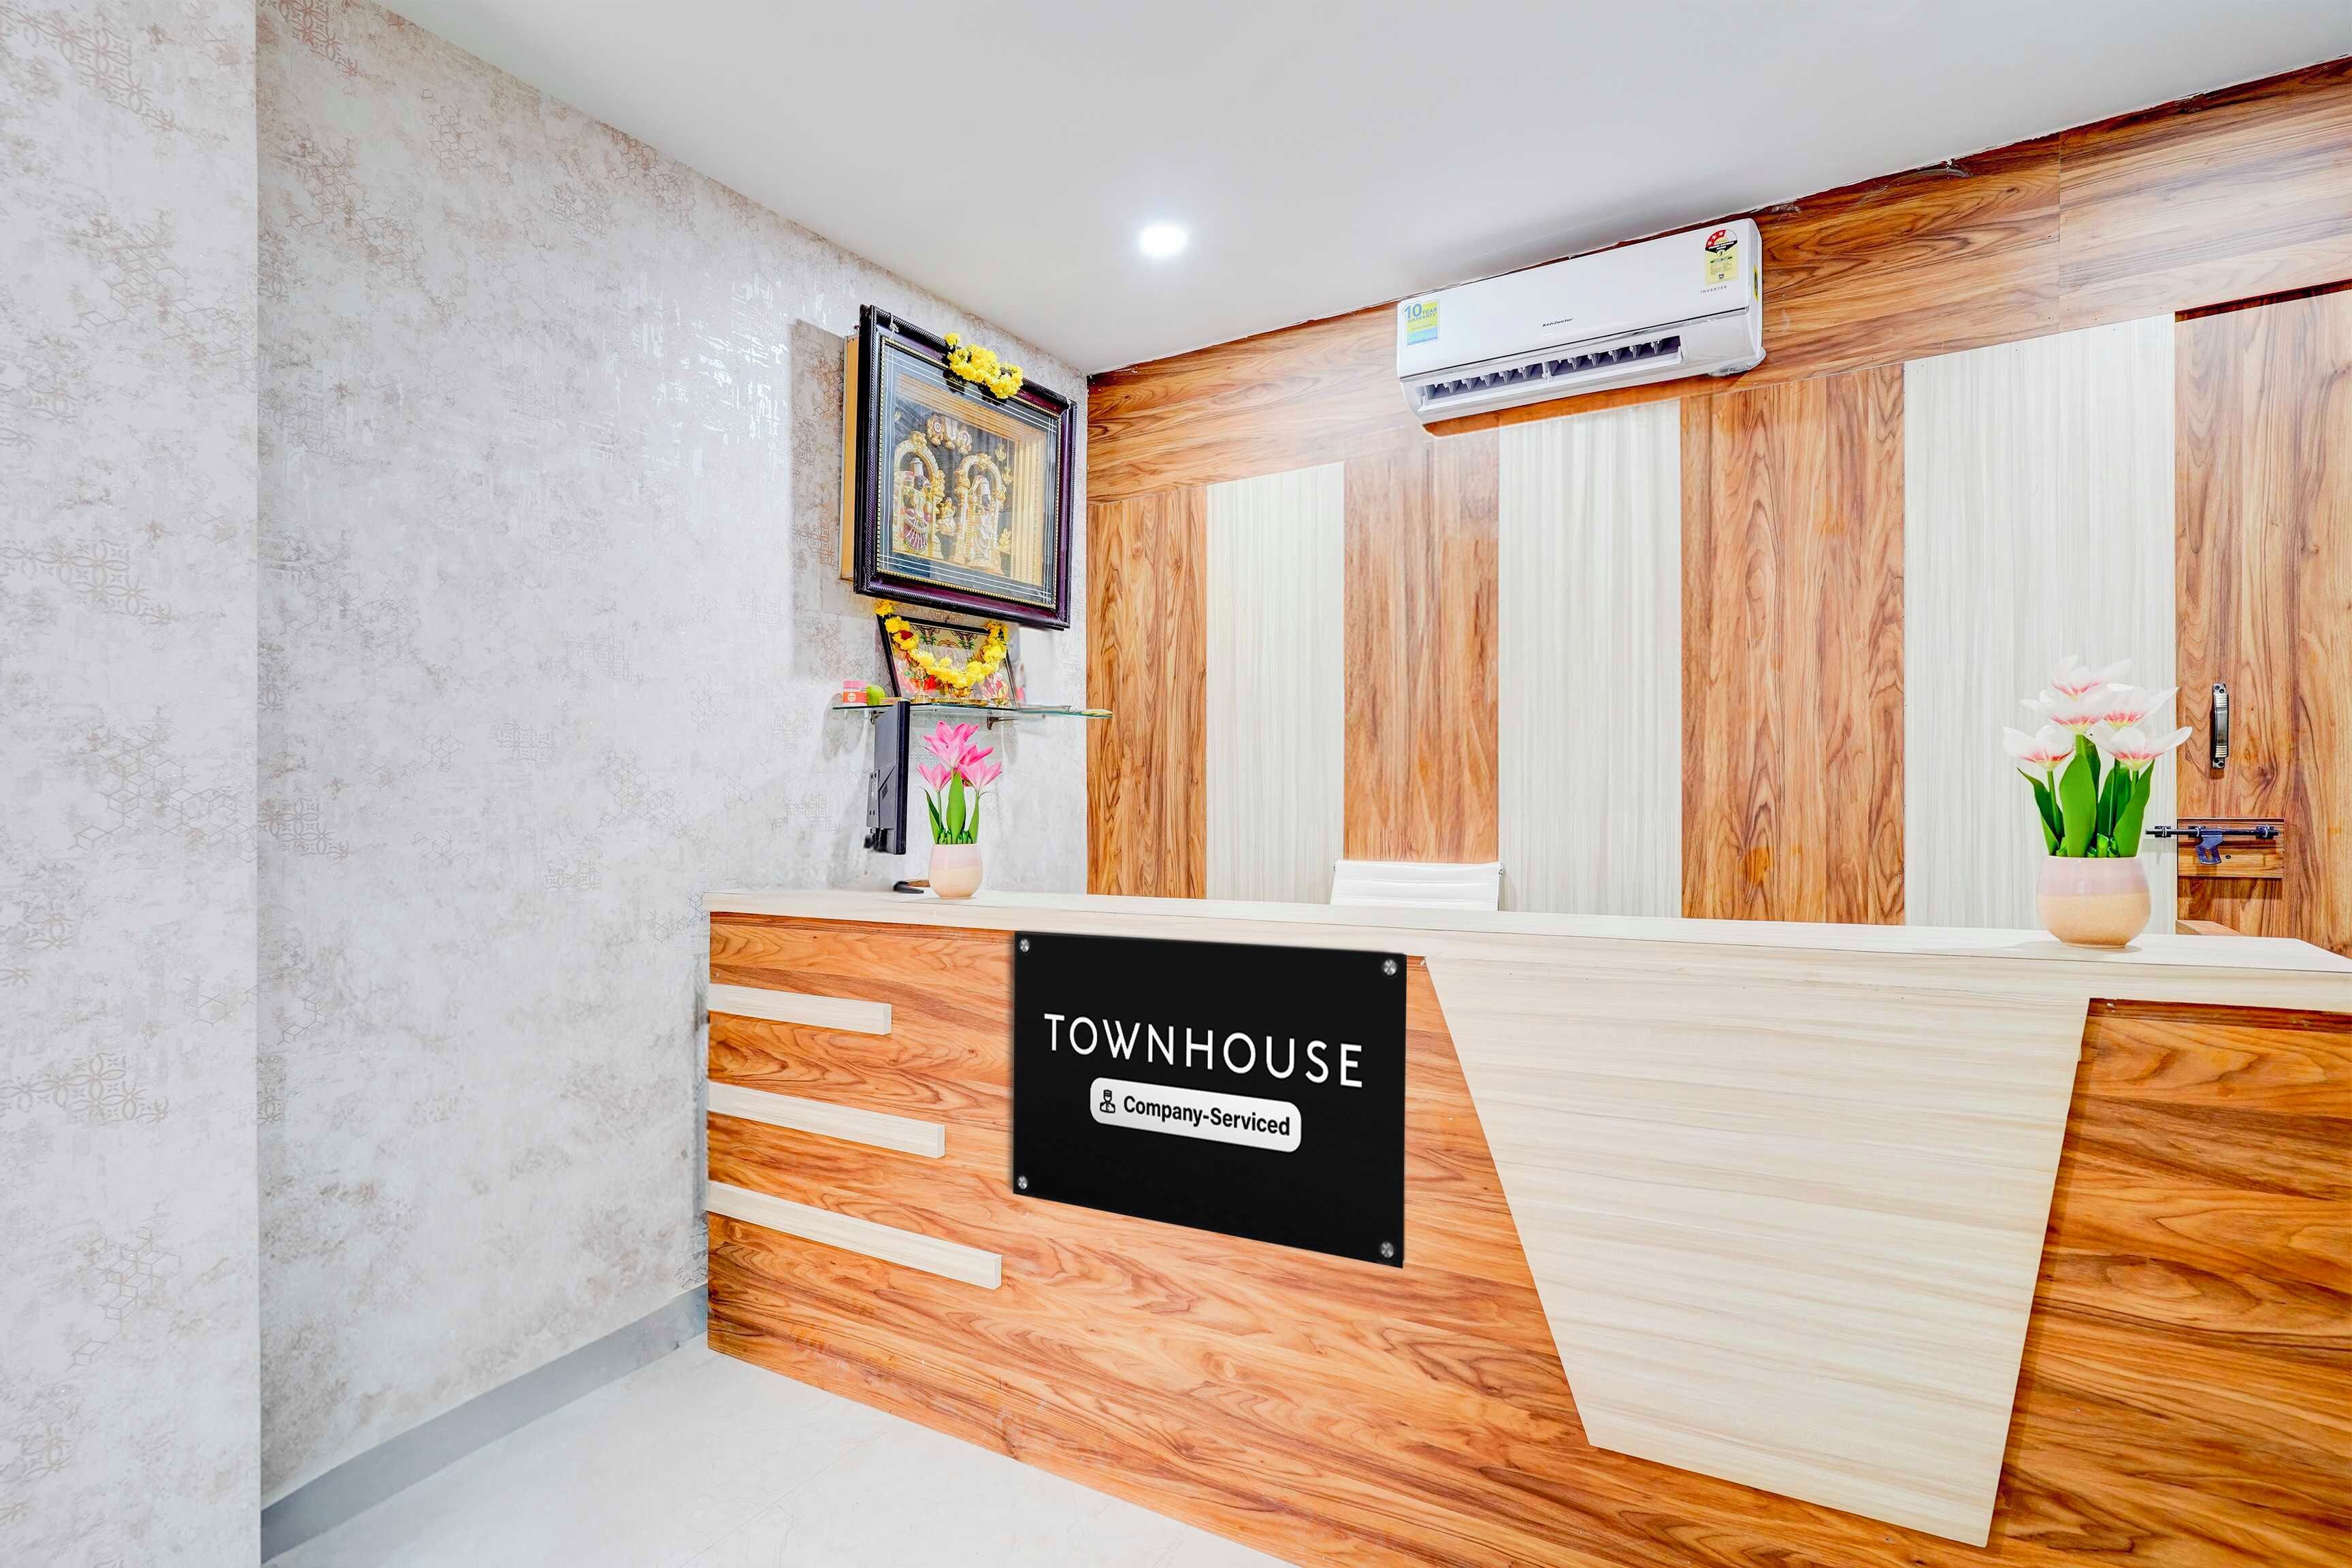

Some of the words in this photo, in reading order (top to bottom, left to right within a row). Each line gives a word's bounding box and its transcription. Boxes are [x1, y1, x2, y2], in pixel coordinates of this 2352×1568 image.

[1700, 285, 1727, 293] INVERTER
[1404, 303, 1422, 319] 10
[1044, 1013, 1362, 1088] TOWNHOUSE
[1124, 1095, 1290, 1136] Company-Serviced
